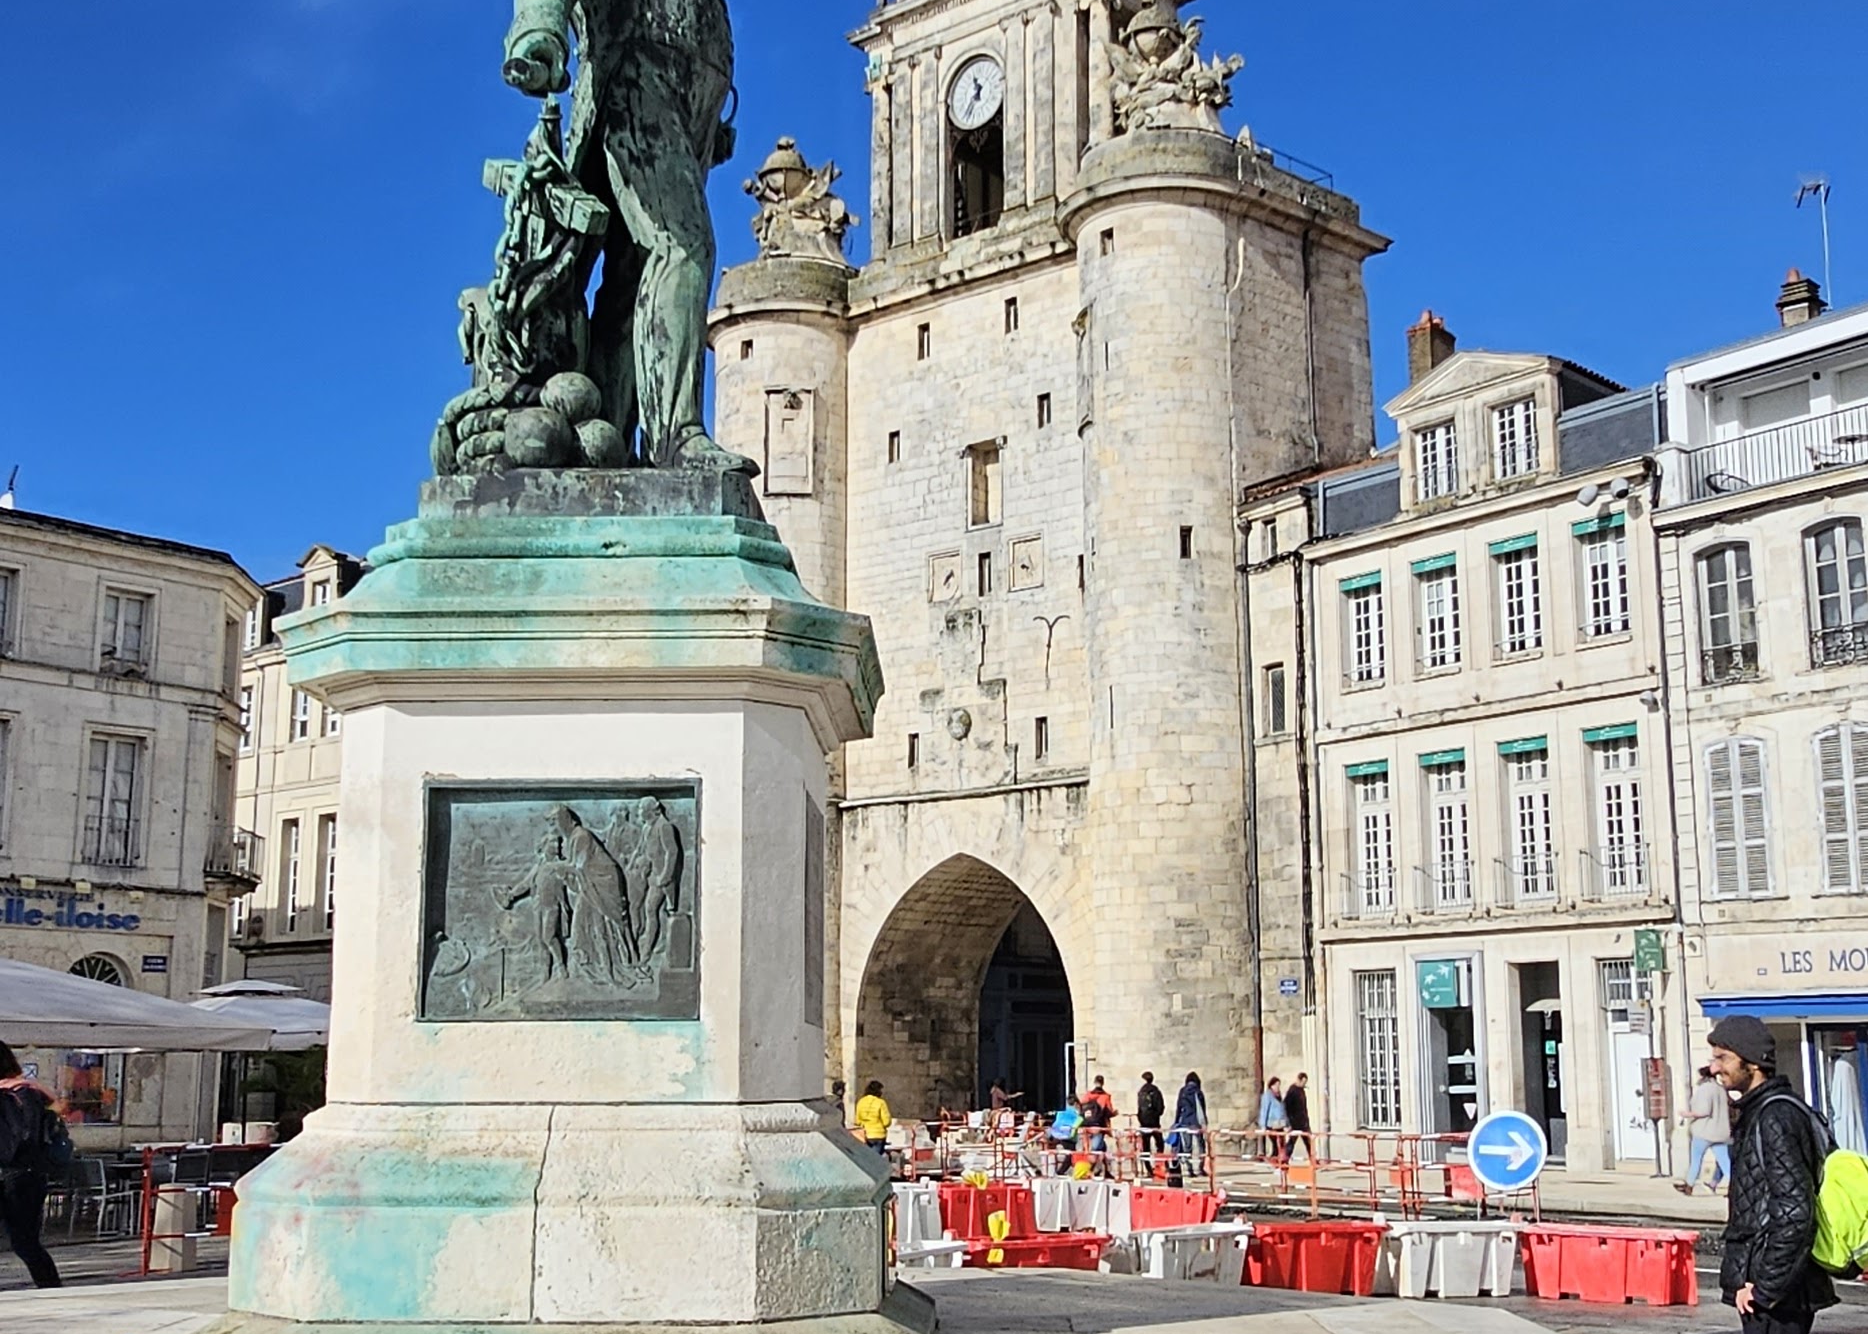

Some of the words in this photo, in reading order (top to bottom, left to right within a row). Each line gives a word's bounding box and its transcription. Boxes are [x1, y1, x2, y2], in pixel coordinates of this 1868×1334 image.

[0, 898, 141, 930] lle-iloise
[1780, 950, 1813, 973] LES
[1829, 947, 1868, 972] MO
